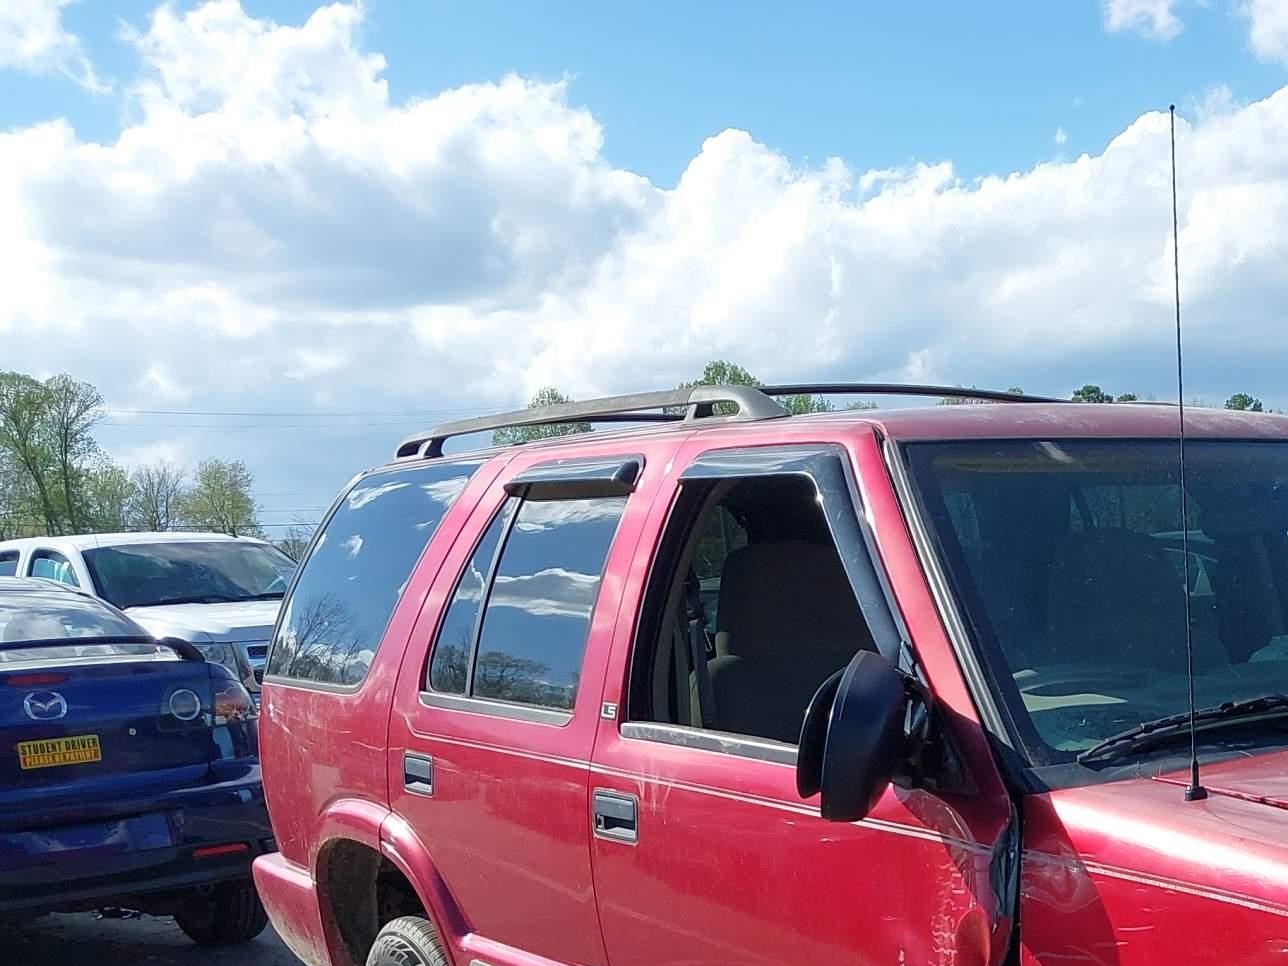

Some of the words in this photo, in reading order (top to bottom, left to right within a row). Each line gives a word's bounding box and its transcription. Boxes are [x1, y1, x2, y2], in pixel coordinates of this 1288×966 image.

[601, 703, 617, 718] LS
[21, 741, 62, 756] STUDENT
[64, 738, 98, 750] DRIVER
